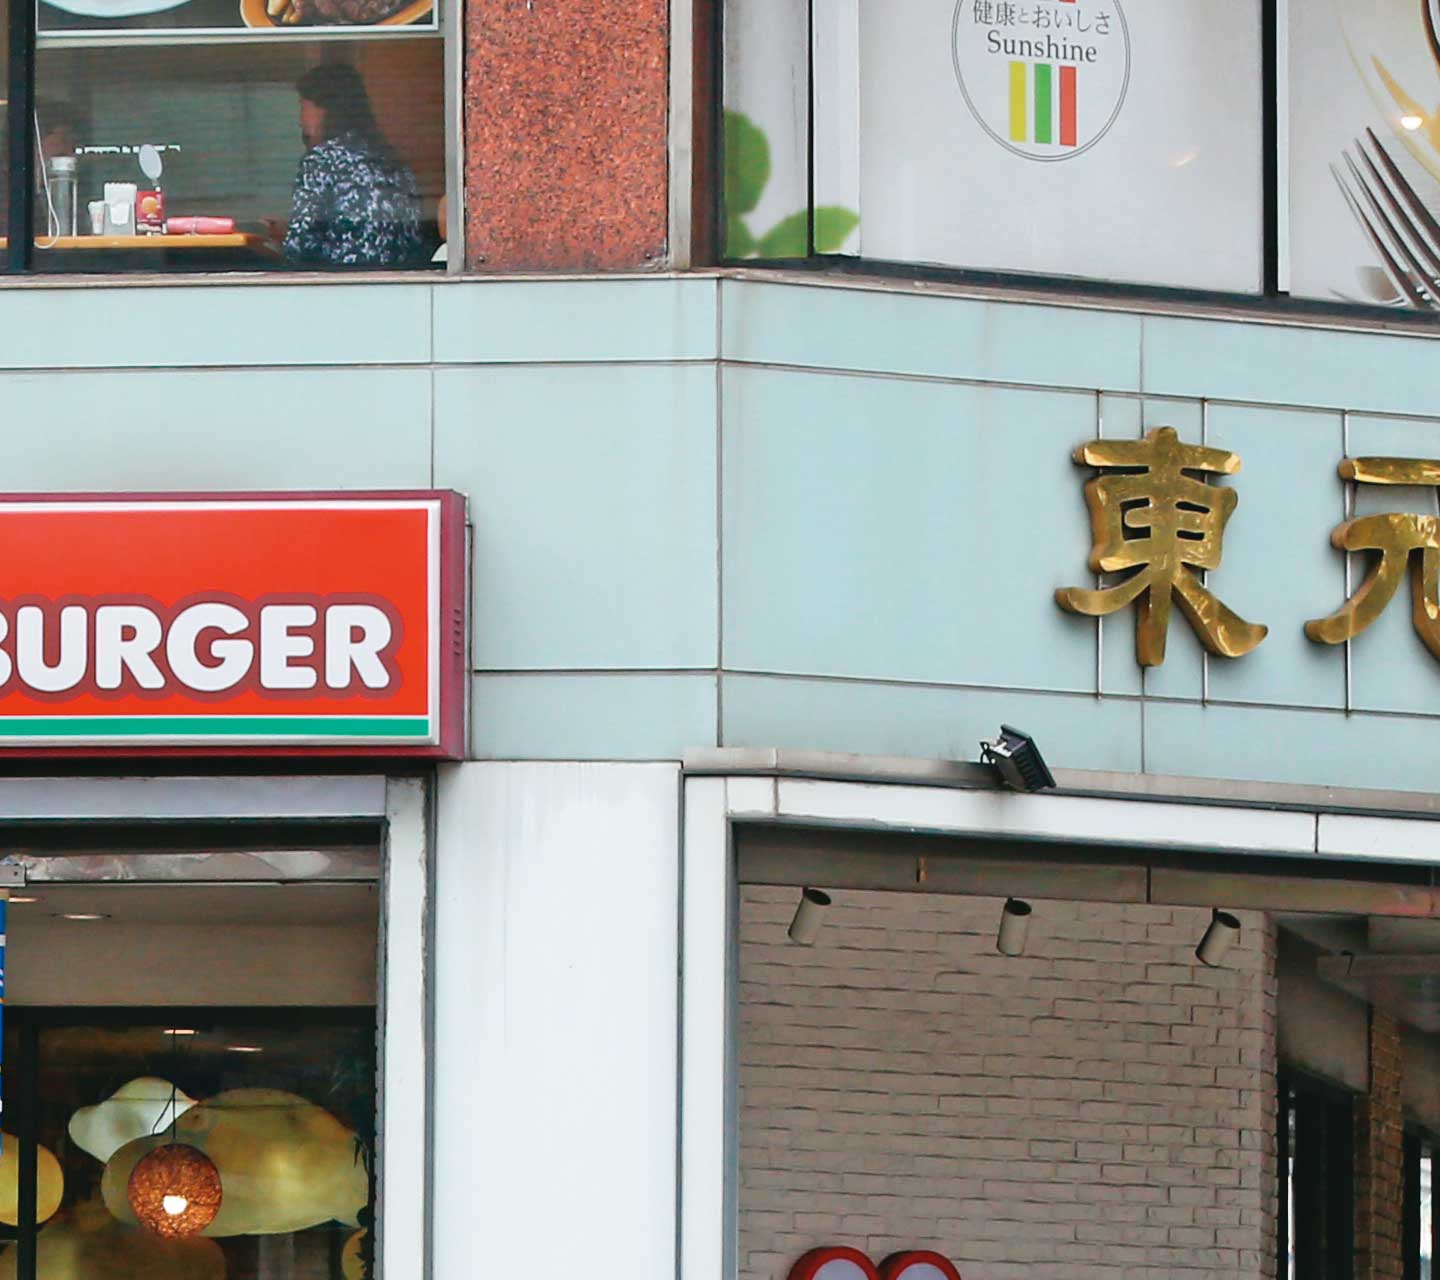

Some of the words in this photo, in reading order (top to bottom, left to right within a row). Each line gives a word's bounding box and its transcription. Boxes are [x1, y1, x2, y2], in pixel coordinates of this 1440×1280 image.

[973, 0, 1110, 35] 健康とおいしさ
[987, 30, 1097, 62] Sunshine
